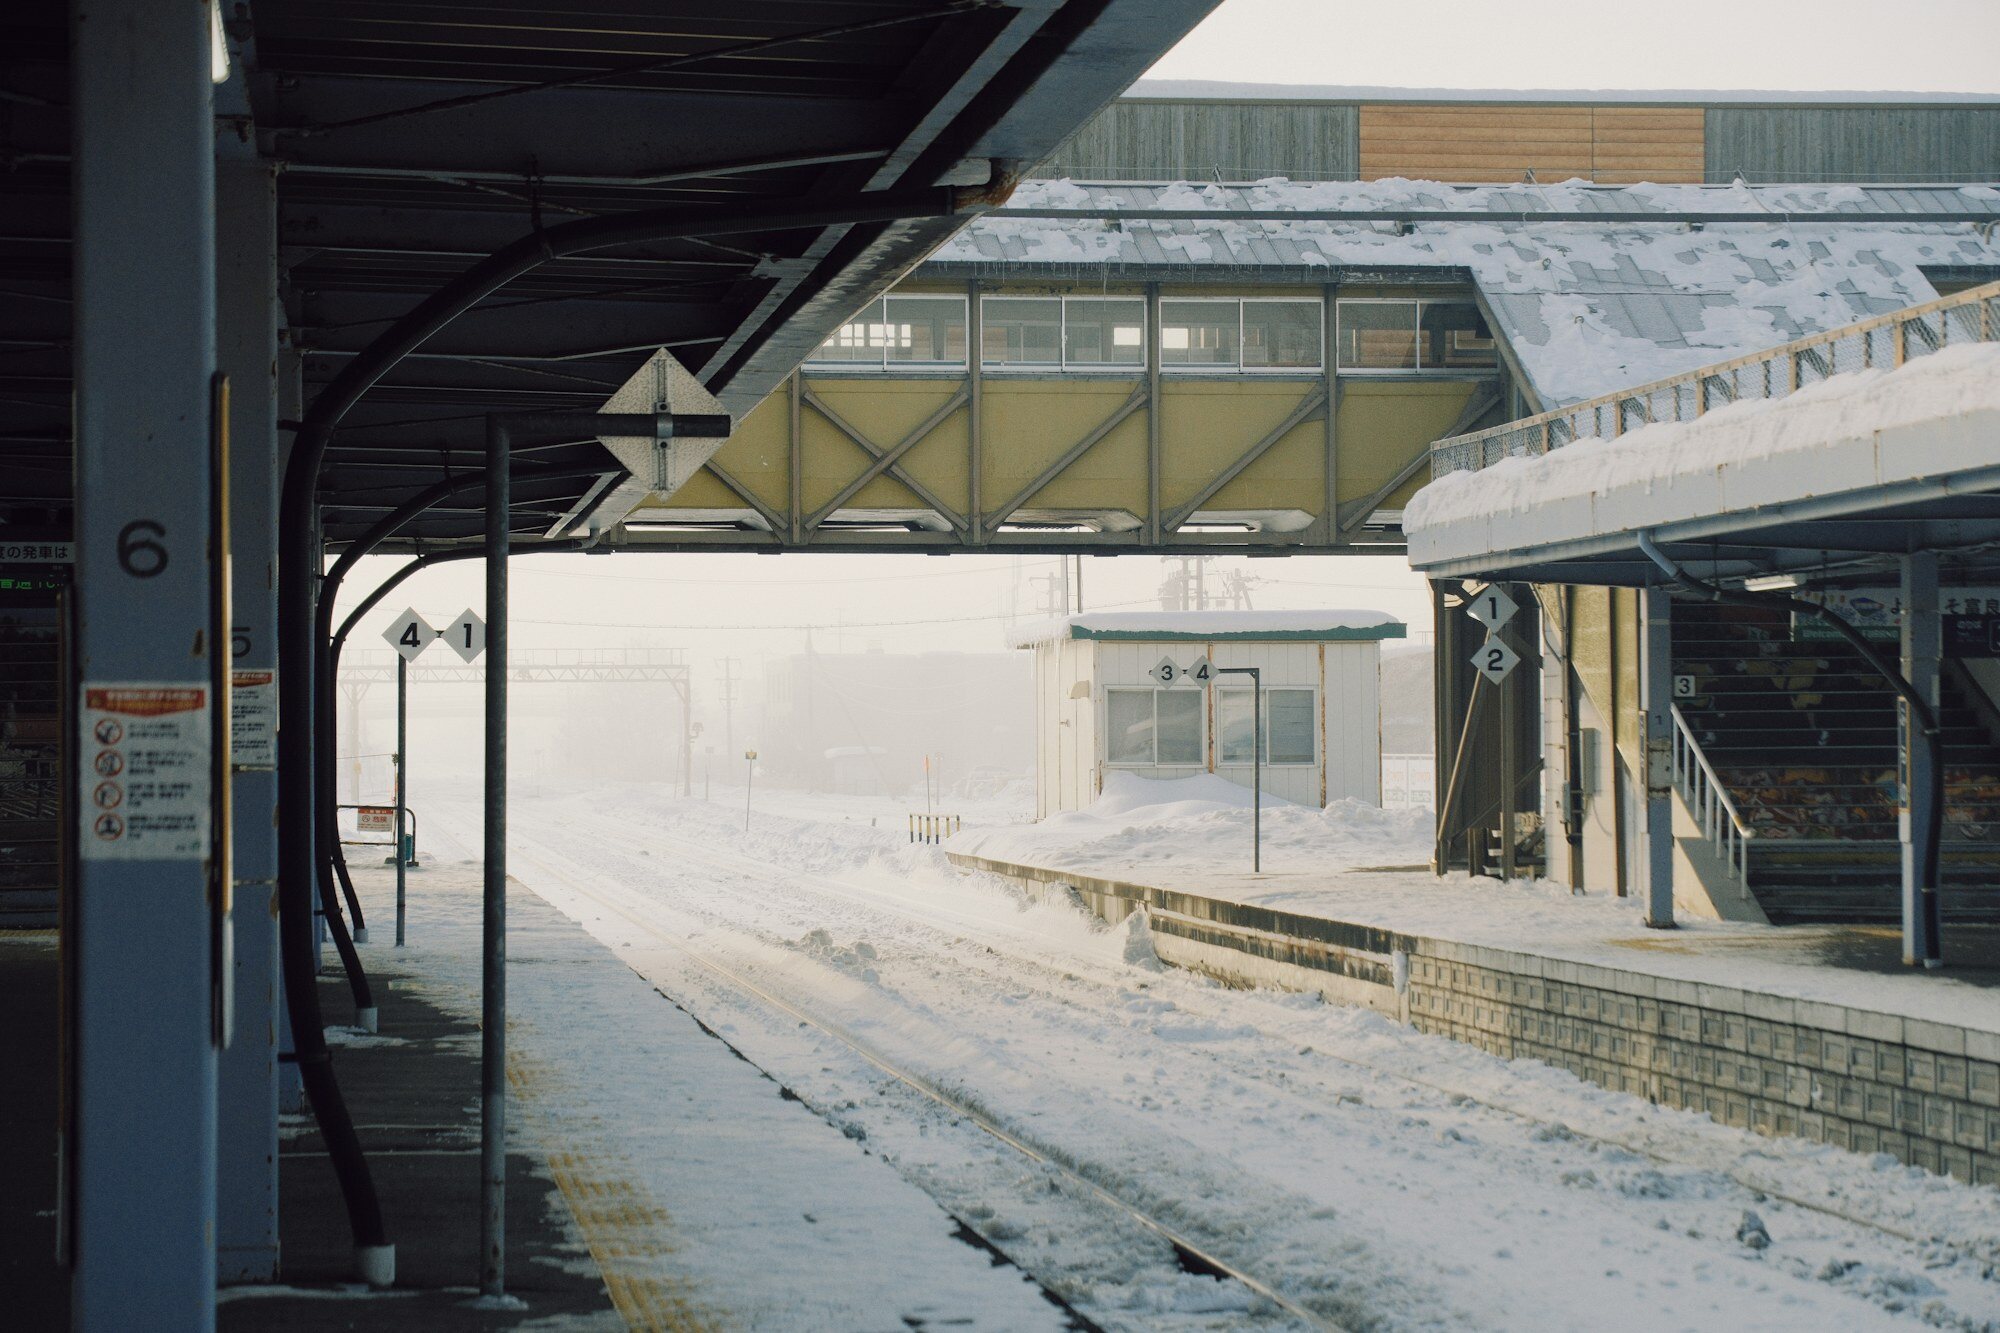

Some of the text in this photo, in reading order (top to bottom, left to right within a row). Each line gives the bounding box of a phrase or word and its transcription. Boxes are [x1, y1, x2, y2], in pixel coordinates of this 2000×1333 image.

[116, 518, 169, 578] 6
[1488, 597, 1497, 619] 1
[400, 622, 472, 649] 4 1
[1488, 648, 1503, 671] 2
[1161, 664, 1209, 681] 3 4
[1679, 678, 1690, 694] 3
